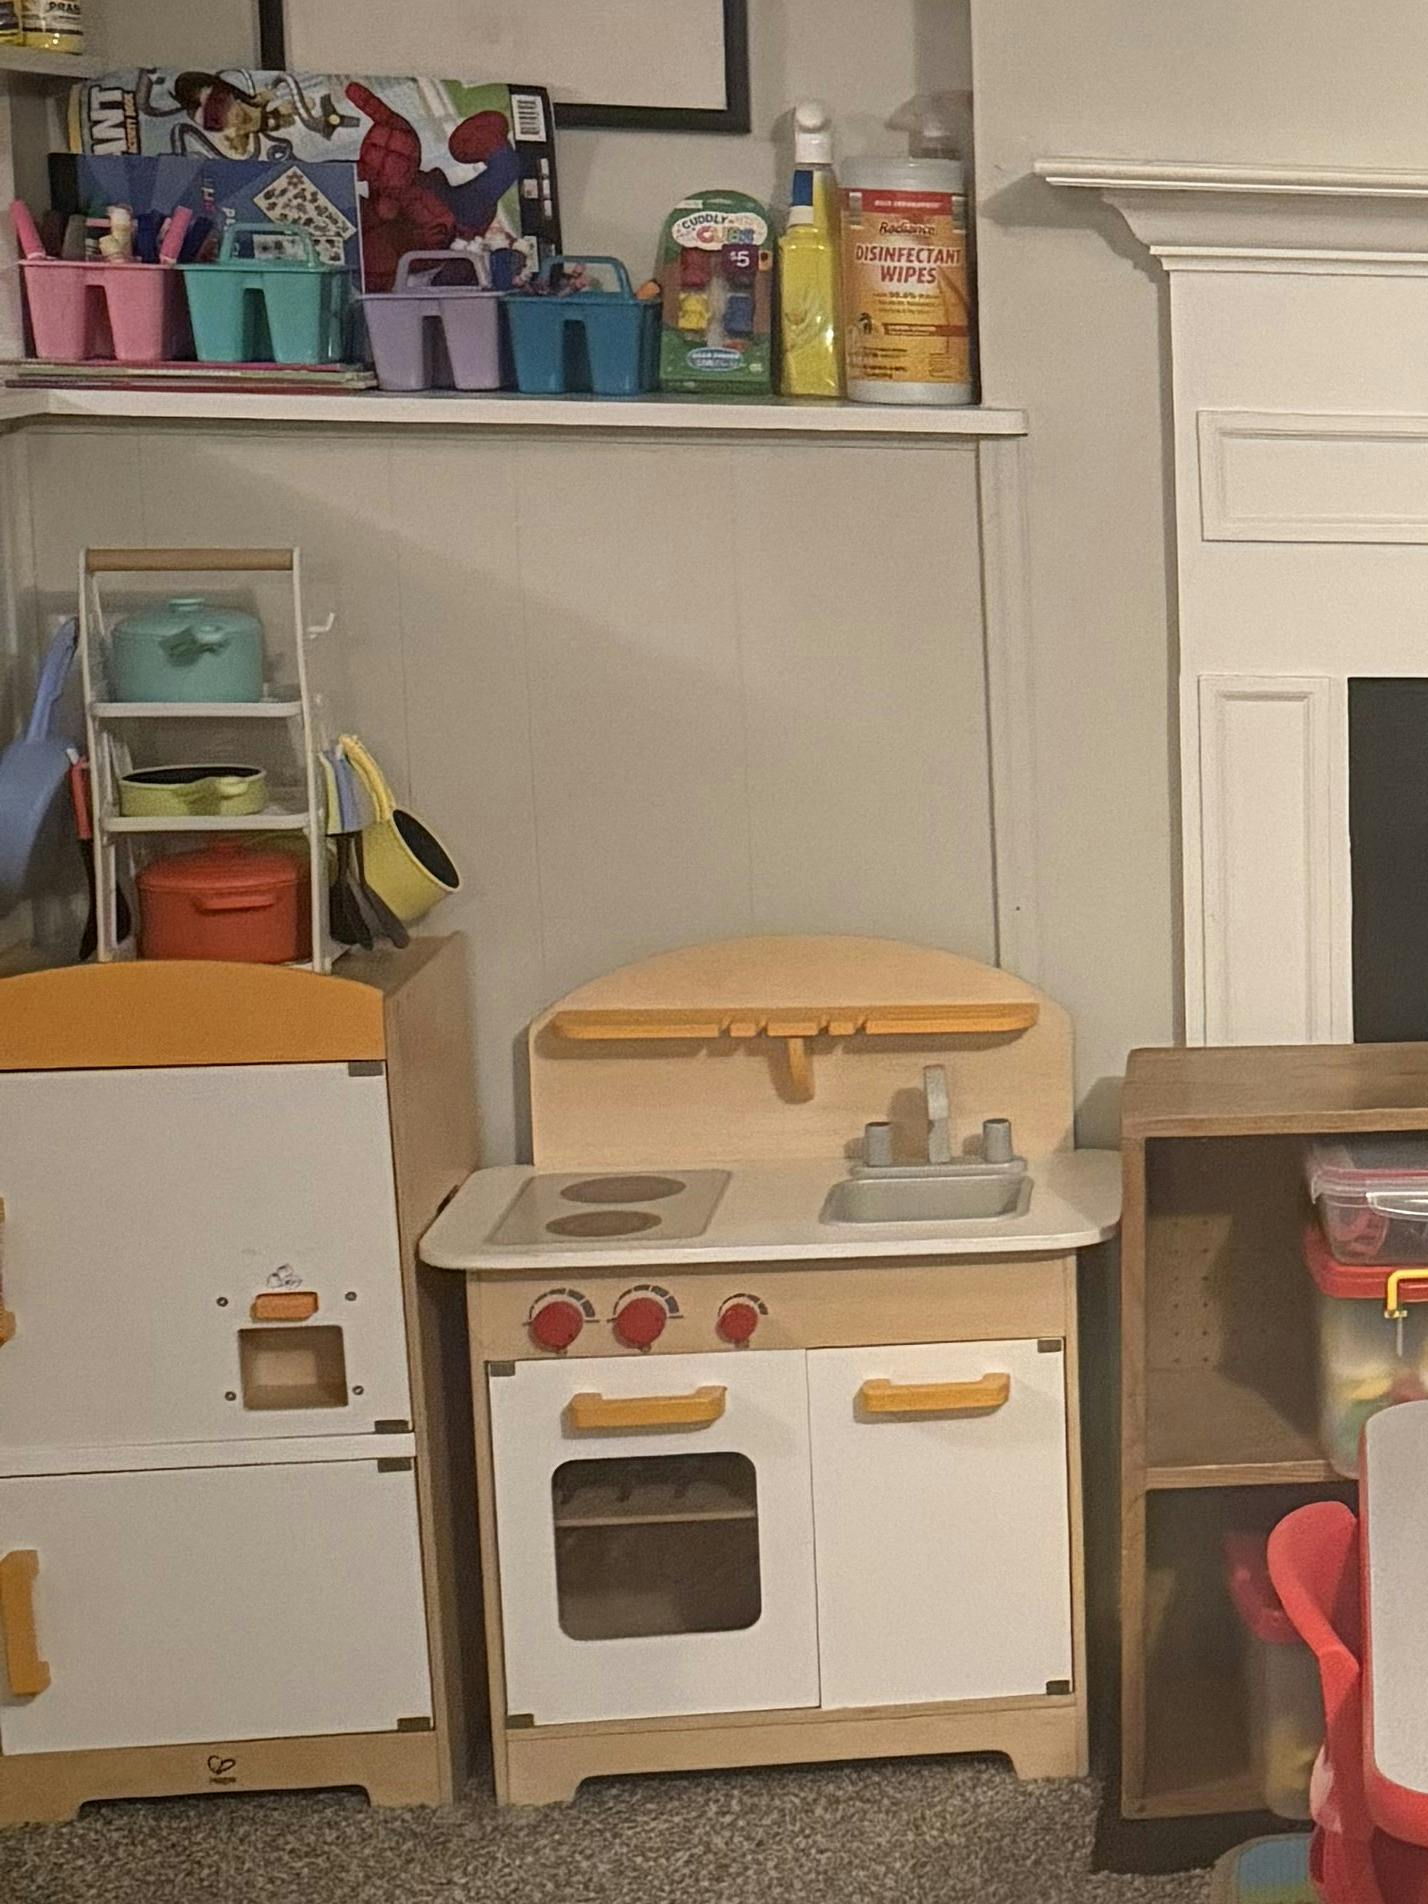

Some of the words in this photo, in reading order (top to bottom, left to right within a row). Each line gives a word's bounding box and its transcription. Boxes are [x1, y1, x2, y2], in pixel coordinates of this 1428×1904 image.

[681, 213, 729, 230] CUDDLY
[729, 250, 750, 268] $5
[855, 244, 961, 266] DISINFECTANT
[880, 265, 937, 284] WIPES
